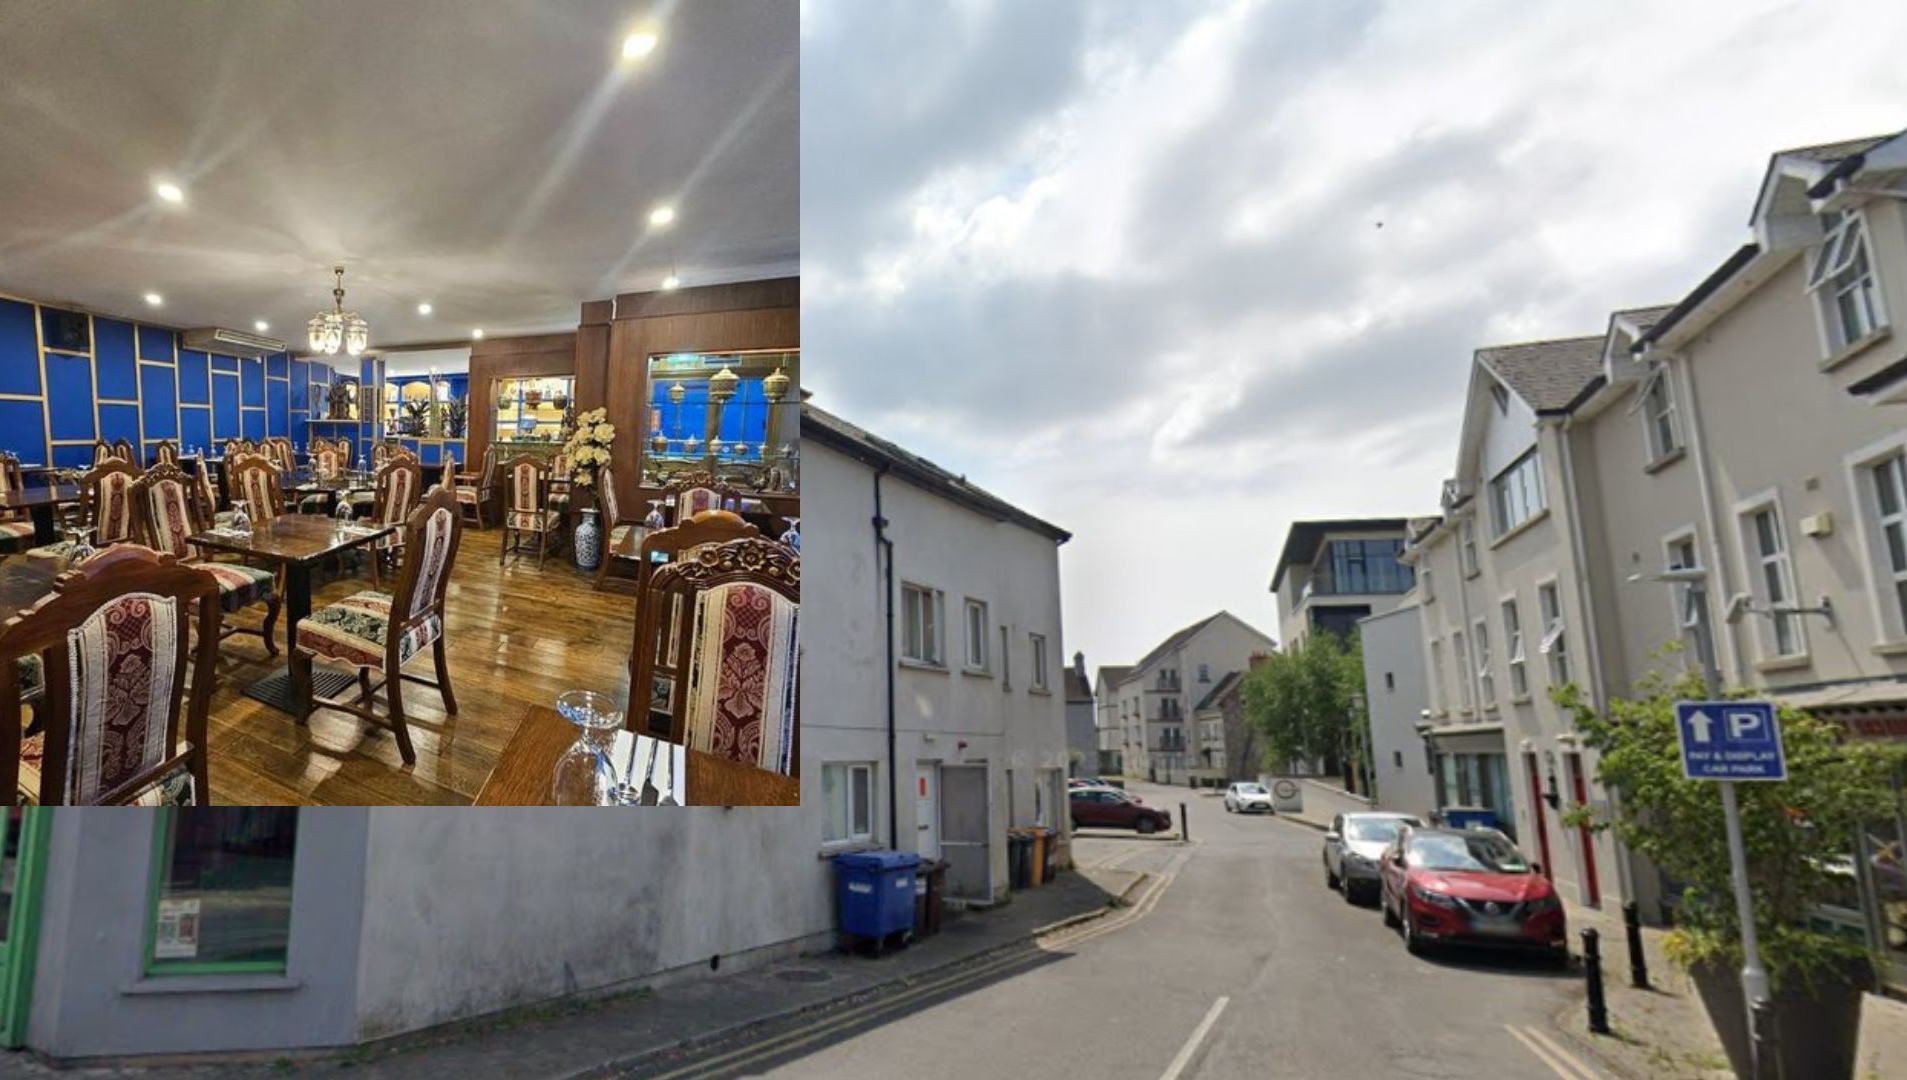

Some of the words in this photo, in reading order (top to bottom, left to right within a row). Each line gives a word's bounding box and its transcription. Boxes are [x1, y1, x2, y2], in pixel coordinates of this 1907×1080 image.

[1729, 713, 1761, 738] P
[1688, 751, 1711, 760] PAY
[1713, 751, 1722, 760] &
[1724, 751, 1775, 761] DISPLAY
[1702, 764, 1728, 773] CAR
[1730, 764, 1765, 773] PARK
